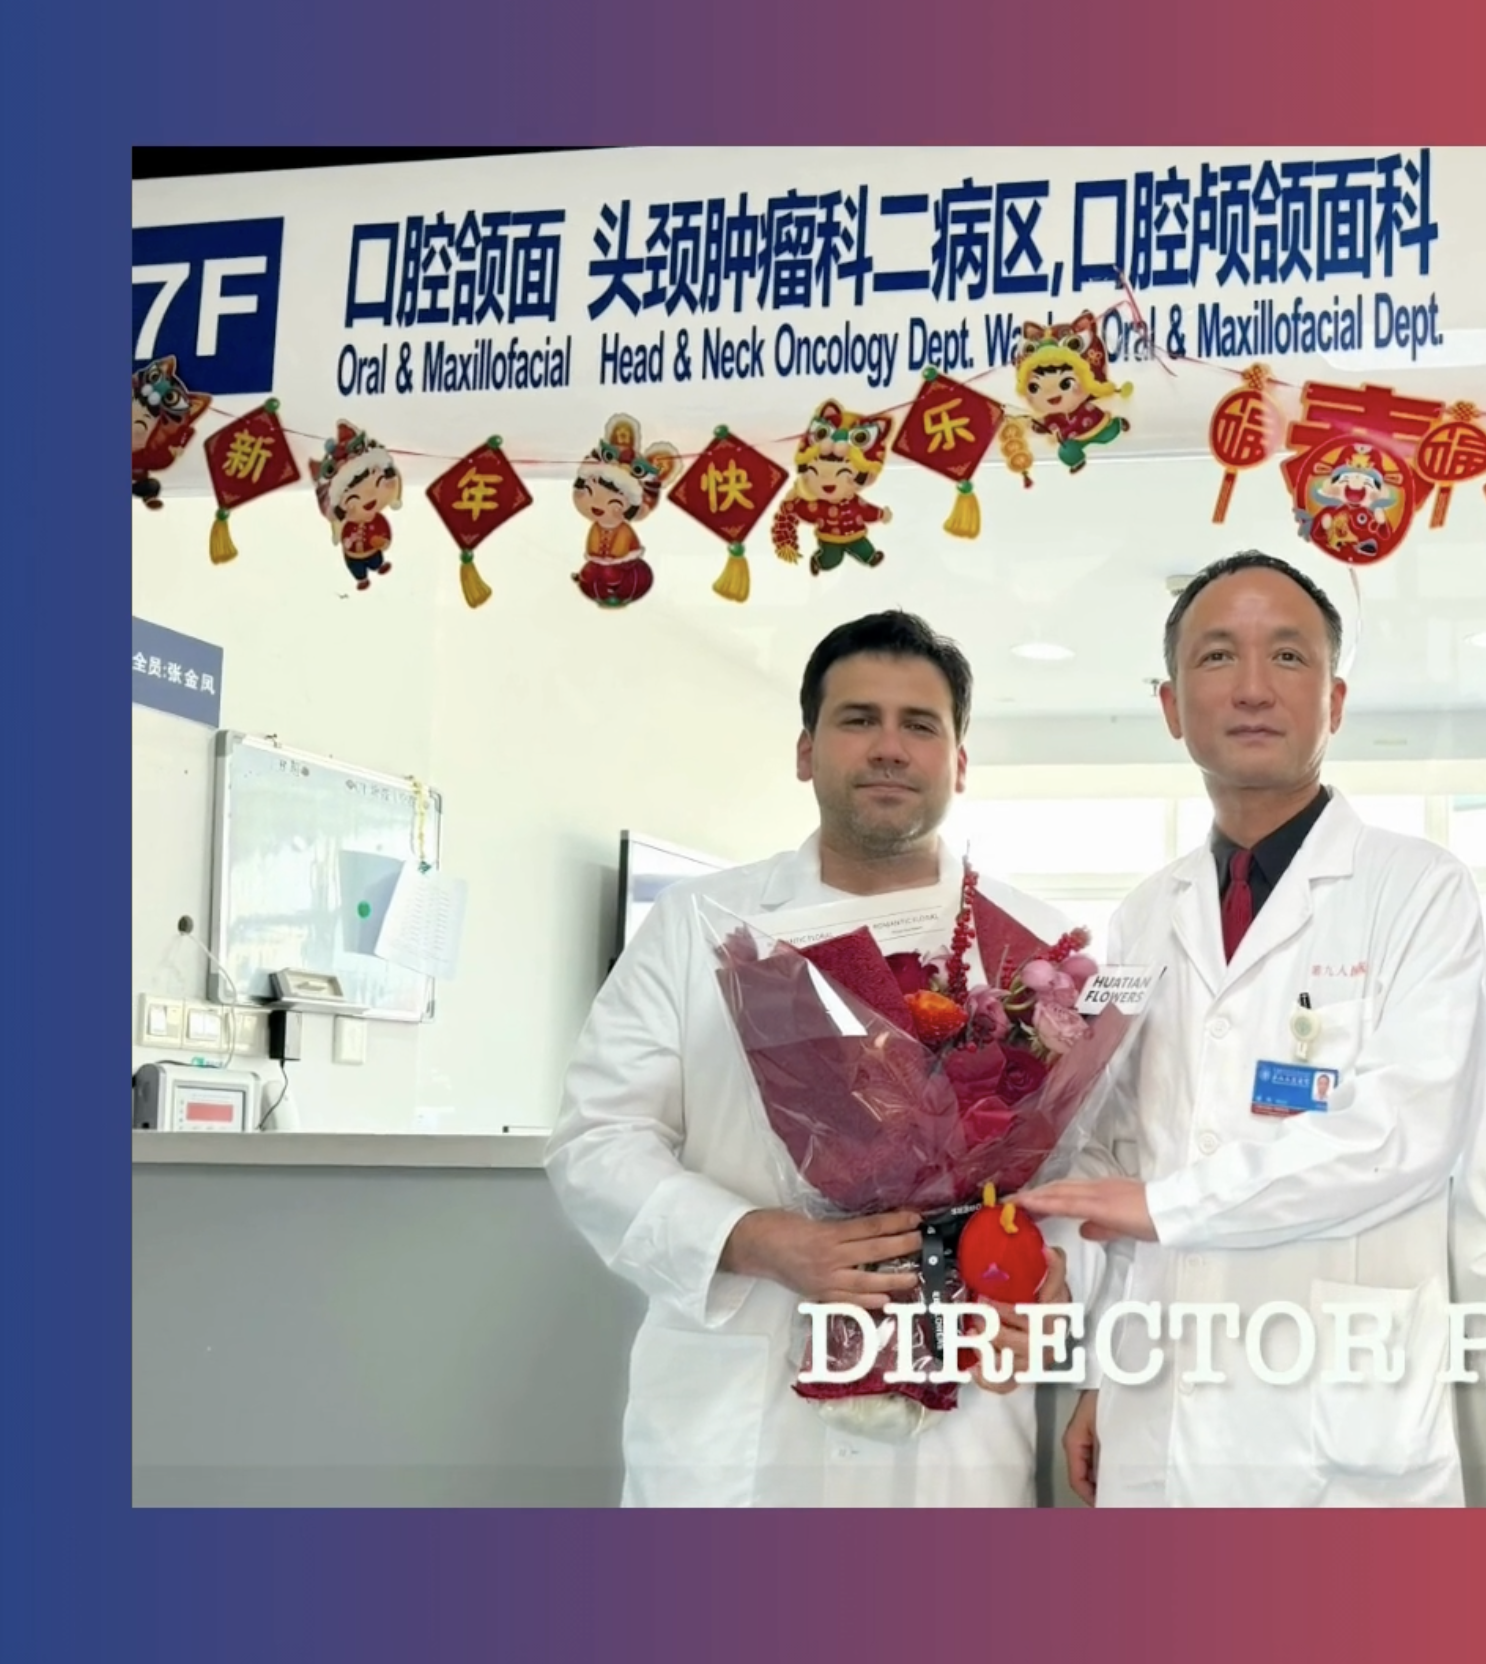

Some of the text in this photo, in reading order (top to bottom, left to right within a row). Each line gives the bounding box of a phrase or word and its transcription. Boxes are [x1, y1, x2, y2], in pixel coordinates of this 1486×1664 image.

[132, 256, 267, 360] 7F
[344, 209, 566, 328] 口腔颌面
[337, 343, 388, 396] Oral
[396, 341, 413, 394] &
[422, 335, 572, 393] Maxillofacial
[600, 330, 665, 385] Head
[673, 328, 692, 382] &
[702, 325, 765, 380] Neck
[774, 320, 898, 388] Oncology
[908, 317, 974, 373] Dept.
[1103, 305, 1156, 362] Oral
[1166, 303, 1186, 359] &
[1198, 294, 1363, 358] Maxillofacial
[1374, 292, 1443, 361] Dept.
[222, 398, 976, 521] 新 年 快 乐
[1085, 990, 1145, 1003] FLOWERS
[1093, 975, 1152, 989] HUATIAN
